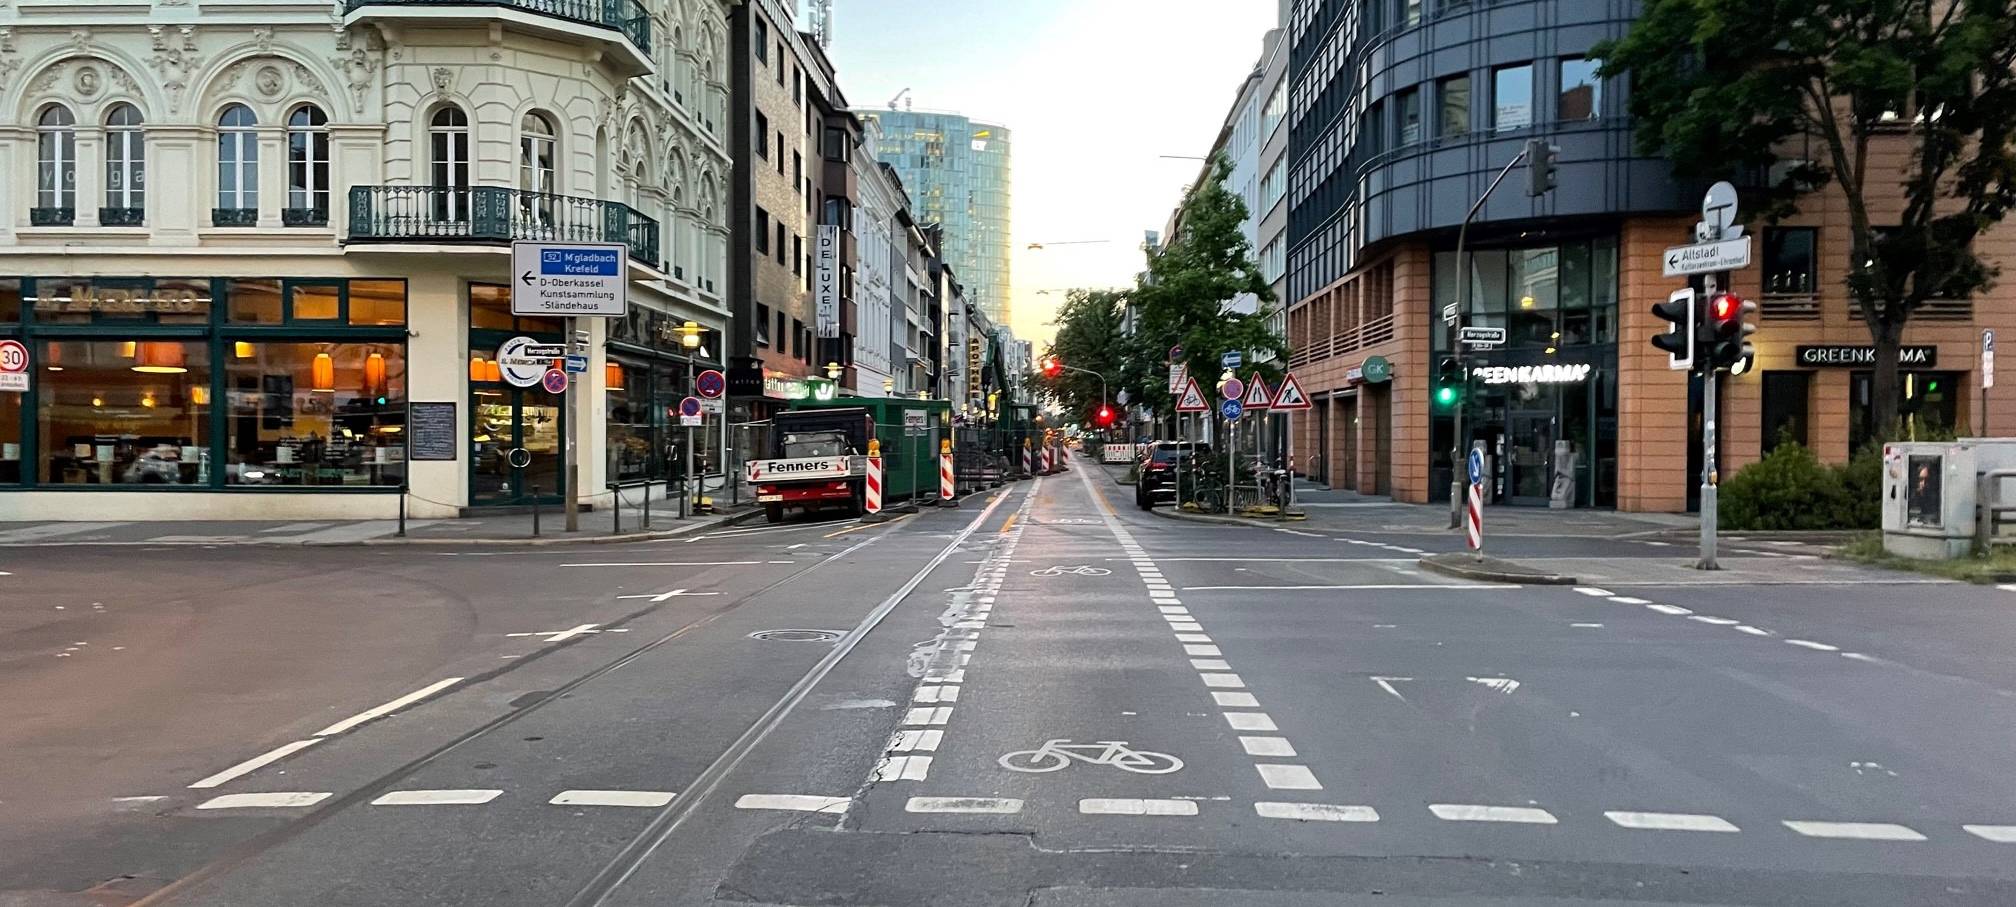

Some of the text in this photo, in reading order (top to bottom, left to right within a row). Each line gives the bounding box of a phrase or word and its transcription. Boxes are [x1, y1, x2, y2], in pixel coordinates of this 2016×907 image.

[42, 168, 145, 188] yoga
[548, 253, 557, 261] 52
[565, 253, 616, 264] M'gladbach
[1682, 247, 1719, 261] Altstadt
[565, 265, 599, 274] Krefeld
[540, 278, 604, 287] D-Oberkassel
[540, 290, 615, 300] Kunstsammlung
[1467, 331, 1500, 340] Herzogstraße
[2, 350, 20, 365] 30
[1803, 347, 1928, 363] GREENKMA
[1368, 364, 1384, 375] GK
[767, 460, 829, 473] Fenners
